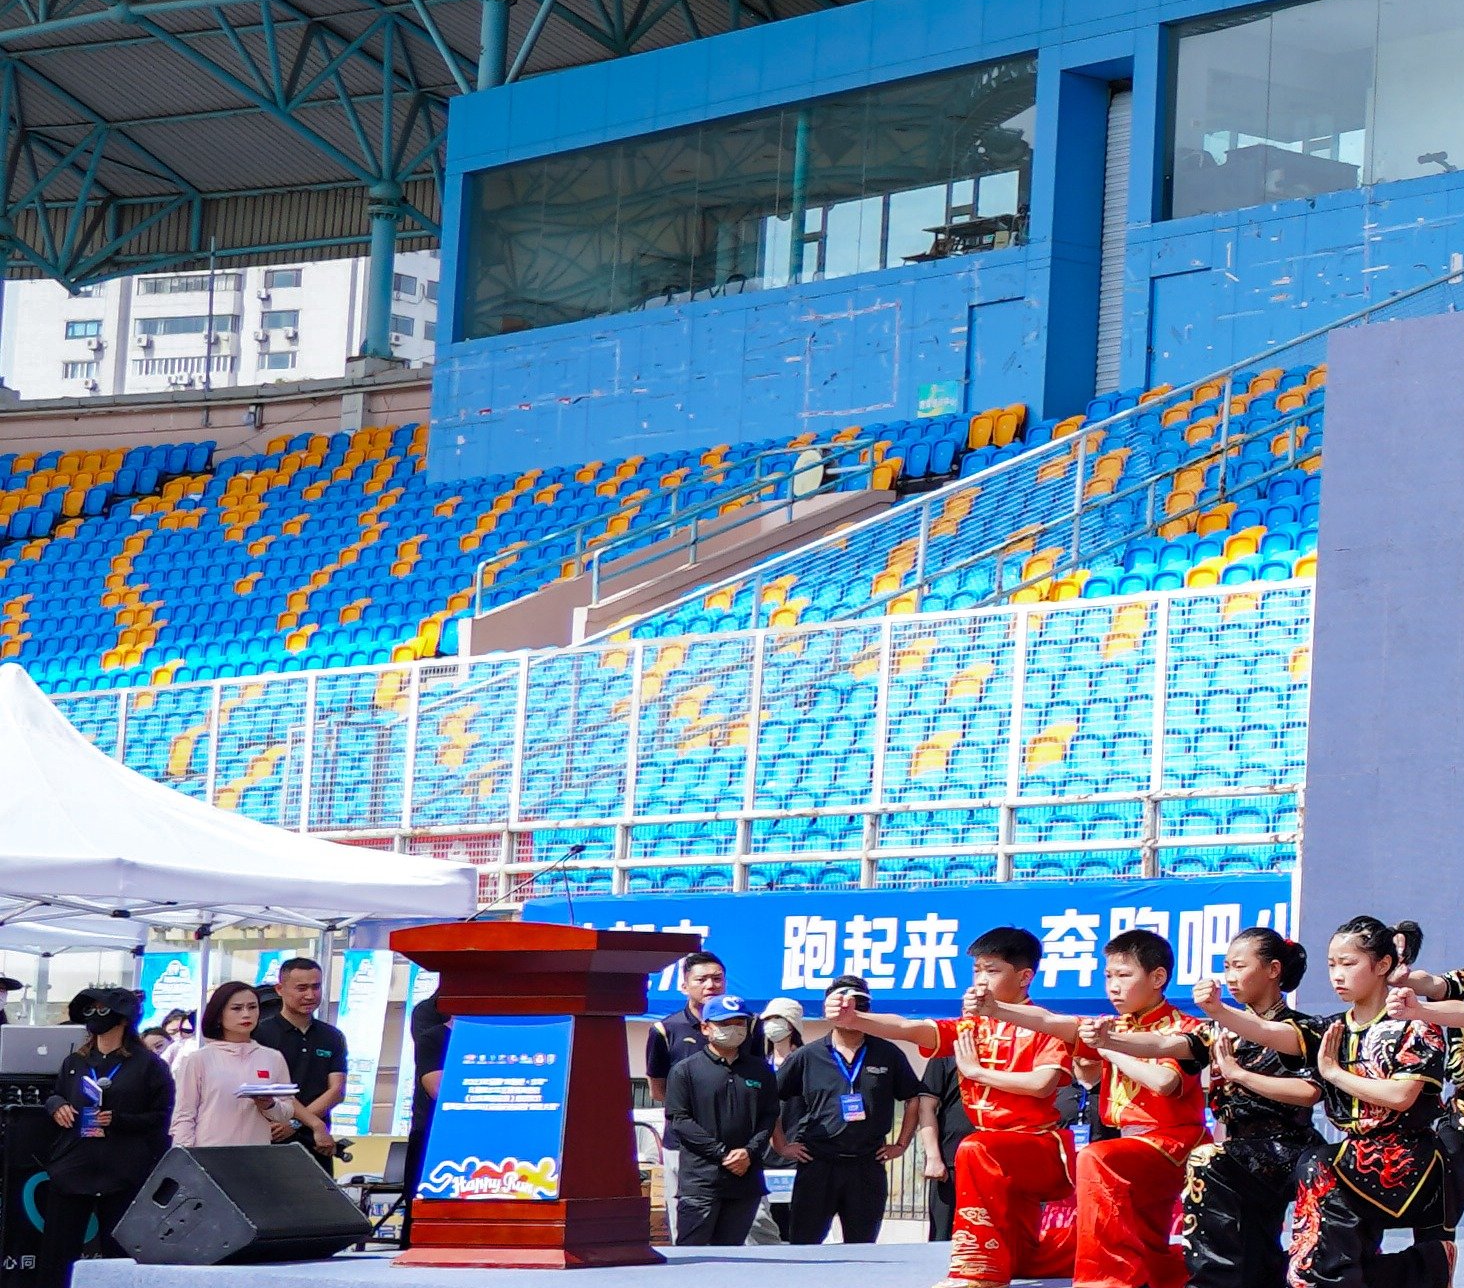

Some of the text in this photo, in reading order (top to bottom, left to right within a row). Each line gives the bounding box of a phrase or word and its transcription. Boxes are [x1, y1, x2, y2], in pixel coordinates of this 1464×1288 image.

[781, 912, 960, 991] 跑起来
[452, 1172, 534, 1198] Happy Run
